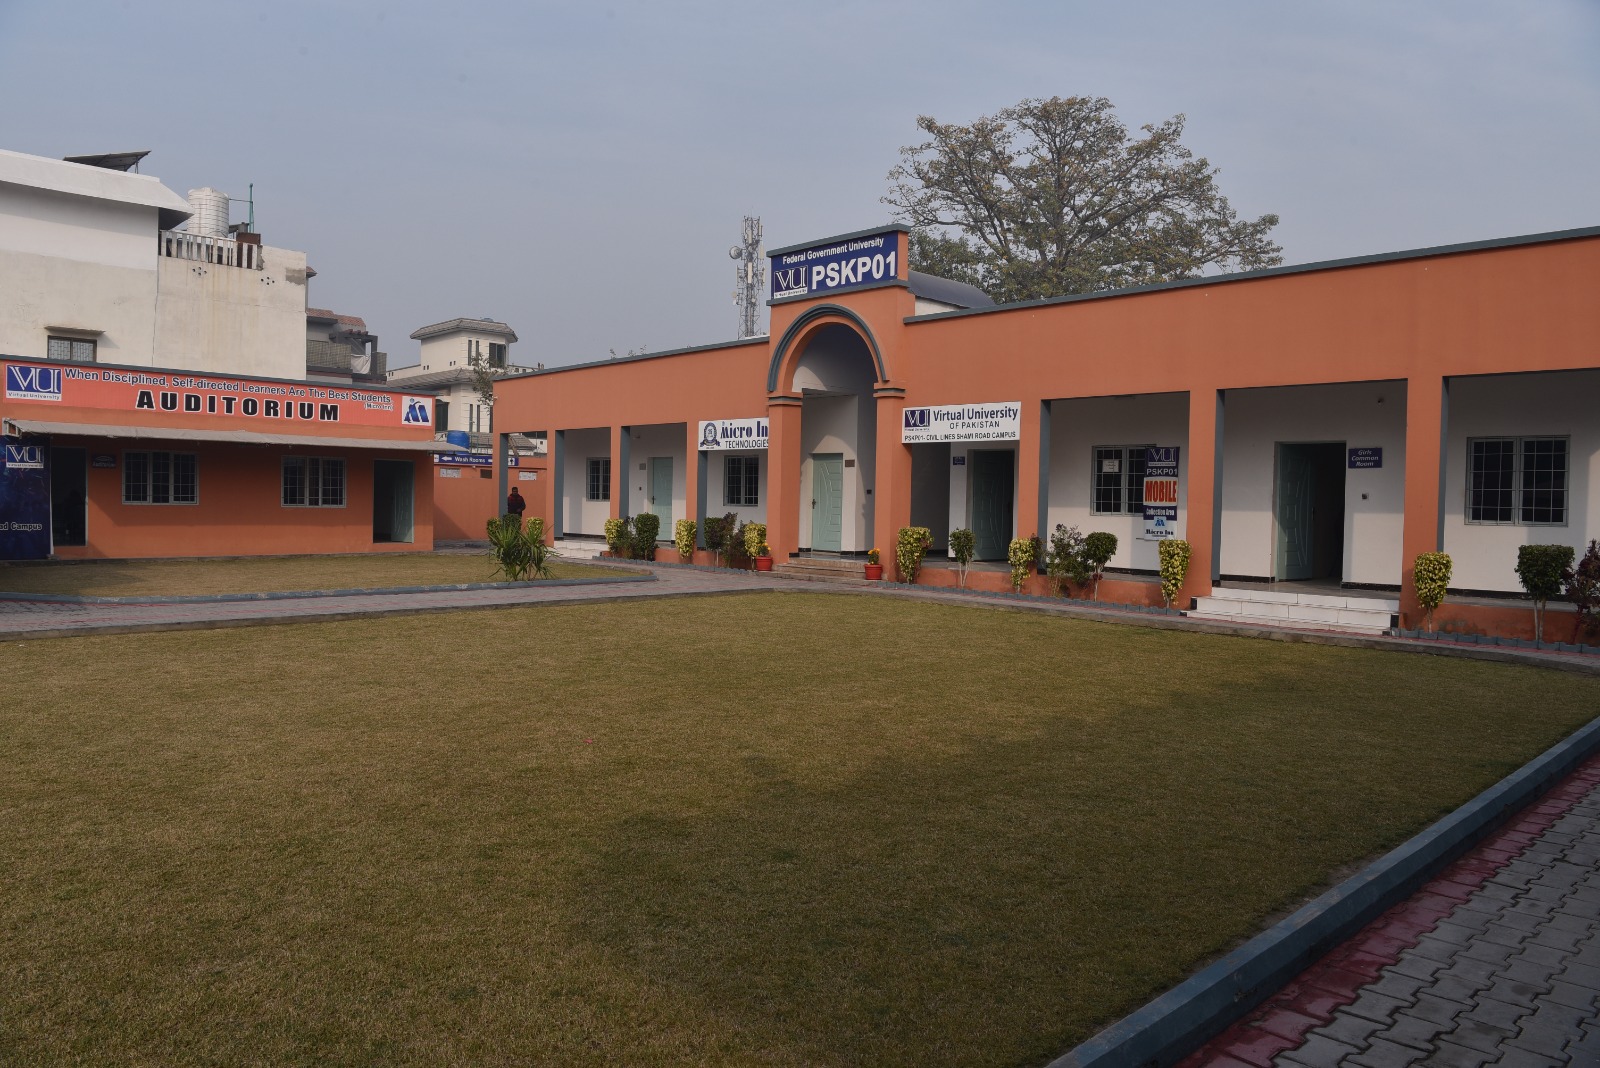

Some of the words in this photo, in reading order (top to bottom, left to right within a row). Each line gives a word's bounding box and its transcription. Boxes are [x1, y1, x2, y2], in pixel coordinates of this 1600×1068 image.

[782, 252, 806, 265] Federal
[807, 244, 848, 260] Government
[848, 237, 884, 252] University
[811, 251, 896, 290] PSKP01
[64, 367, 99, 381] When
[102, 370, 169, 388] Disciplined,
[172, 377, 239, 392] Self-directed
[242, 384, 286, 396] Learners
[288, 386, 306, 398] Are
[308, 388, 326, 399] The
[328, 390, 350, 401] Best
[351, 392, 391, 404] Students
[136, 389, 340, 422] AUDITORIUM
[933, 408, 965, 422] Virtual
[967, 405, 1019, 421] University
[720, 422, 753, 439] Micro
[949, 422, 960, 430] OF
[961, 420, 1000, 429] PAKISTAN
[940, 432, 956, 440] LINES
[975, 431, 991, 439] ROAD
[991, 431, 1016, 439] CAMPUS
[1146, 468, 1178, 476] PSKP01
[1144, 480, 1177, 503] MOBILE
[11, 521, 43, 532] Campus
